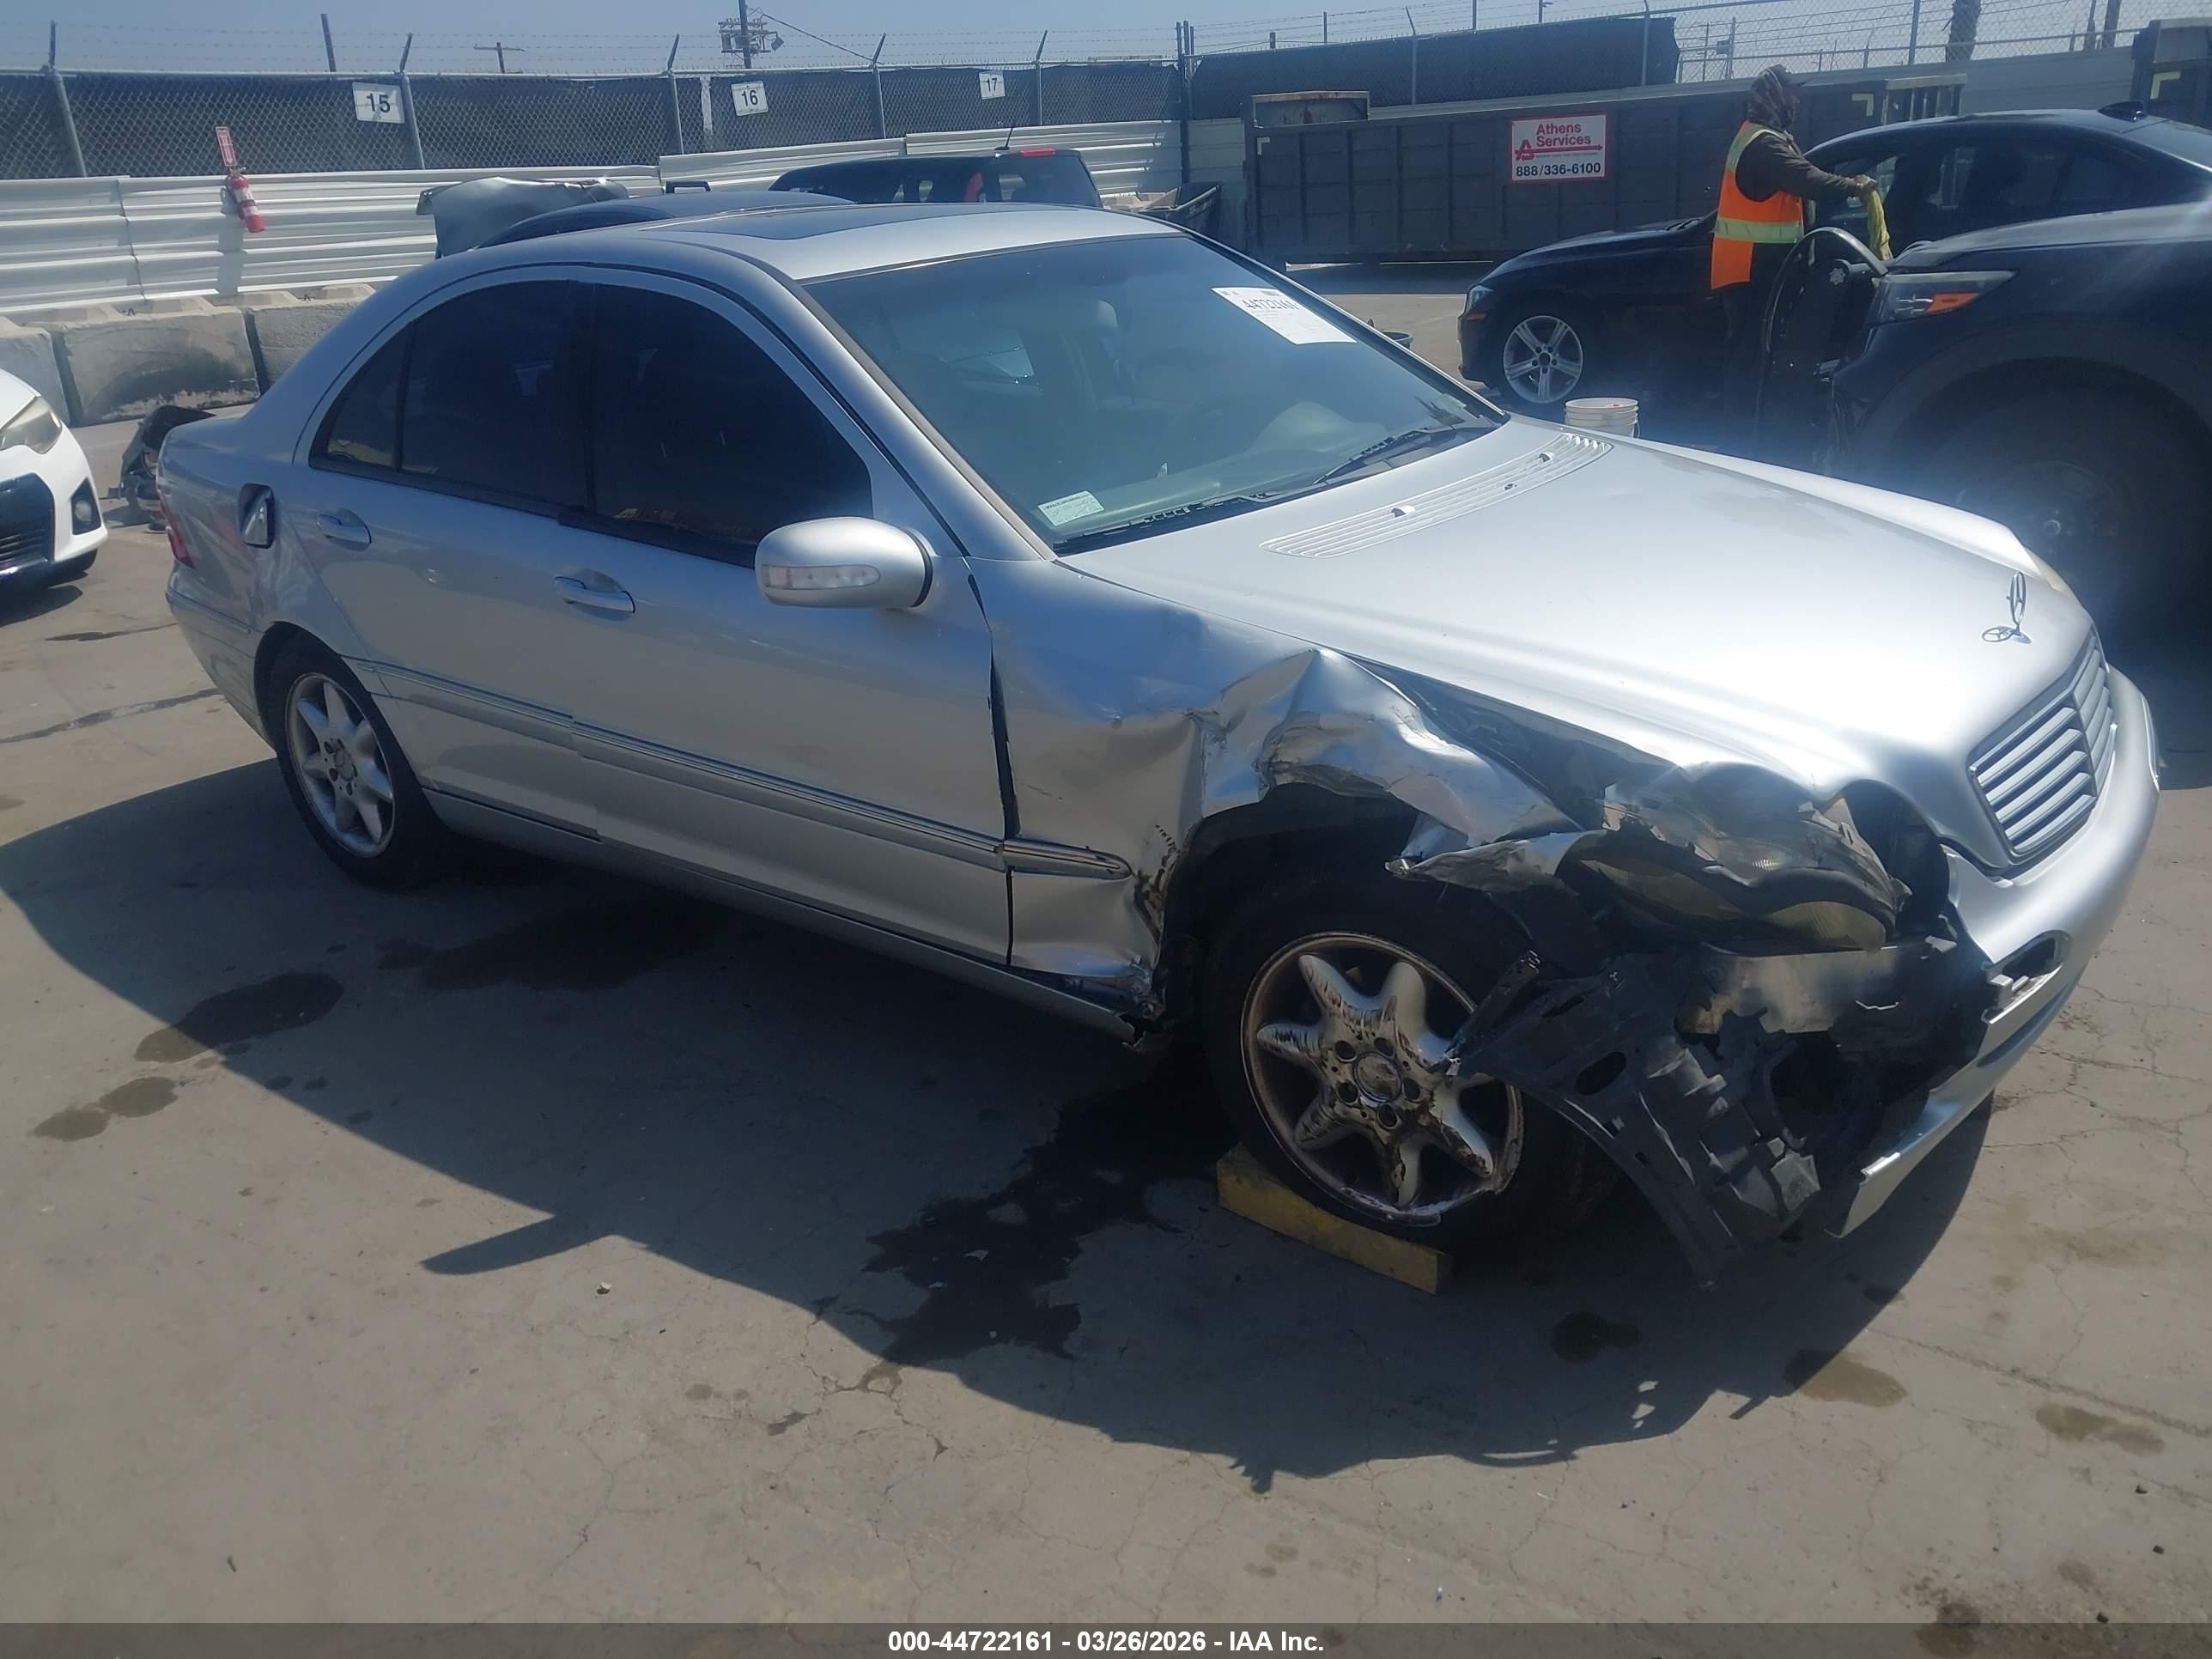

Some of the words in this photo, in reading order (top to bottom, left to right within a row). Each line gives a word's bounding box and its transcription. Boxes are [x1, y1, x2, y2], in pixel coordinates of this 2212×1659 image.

[986, 77, 998, 92] 17
[366, 93, 391, 112] 15
[741, 89, 758, 106] 16
[1536, 123, 1582, 135] Athens
[1536, 134, 1591, 147] Services
[1516, 162, 1601, 176] 888/336-6100
